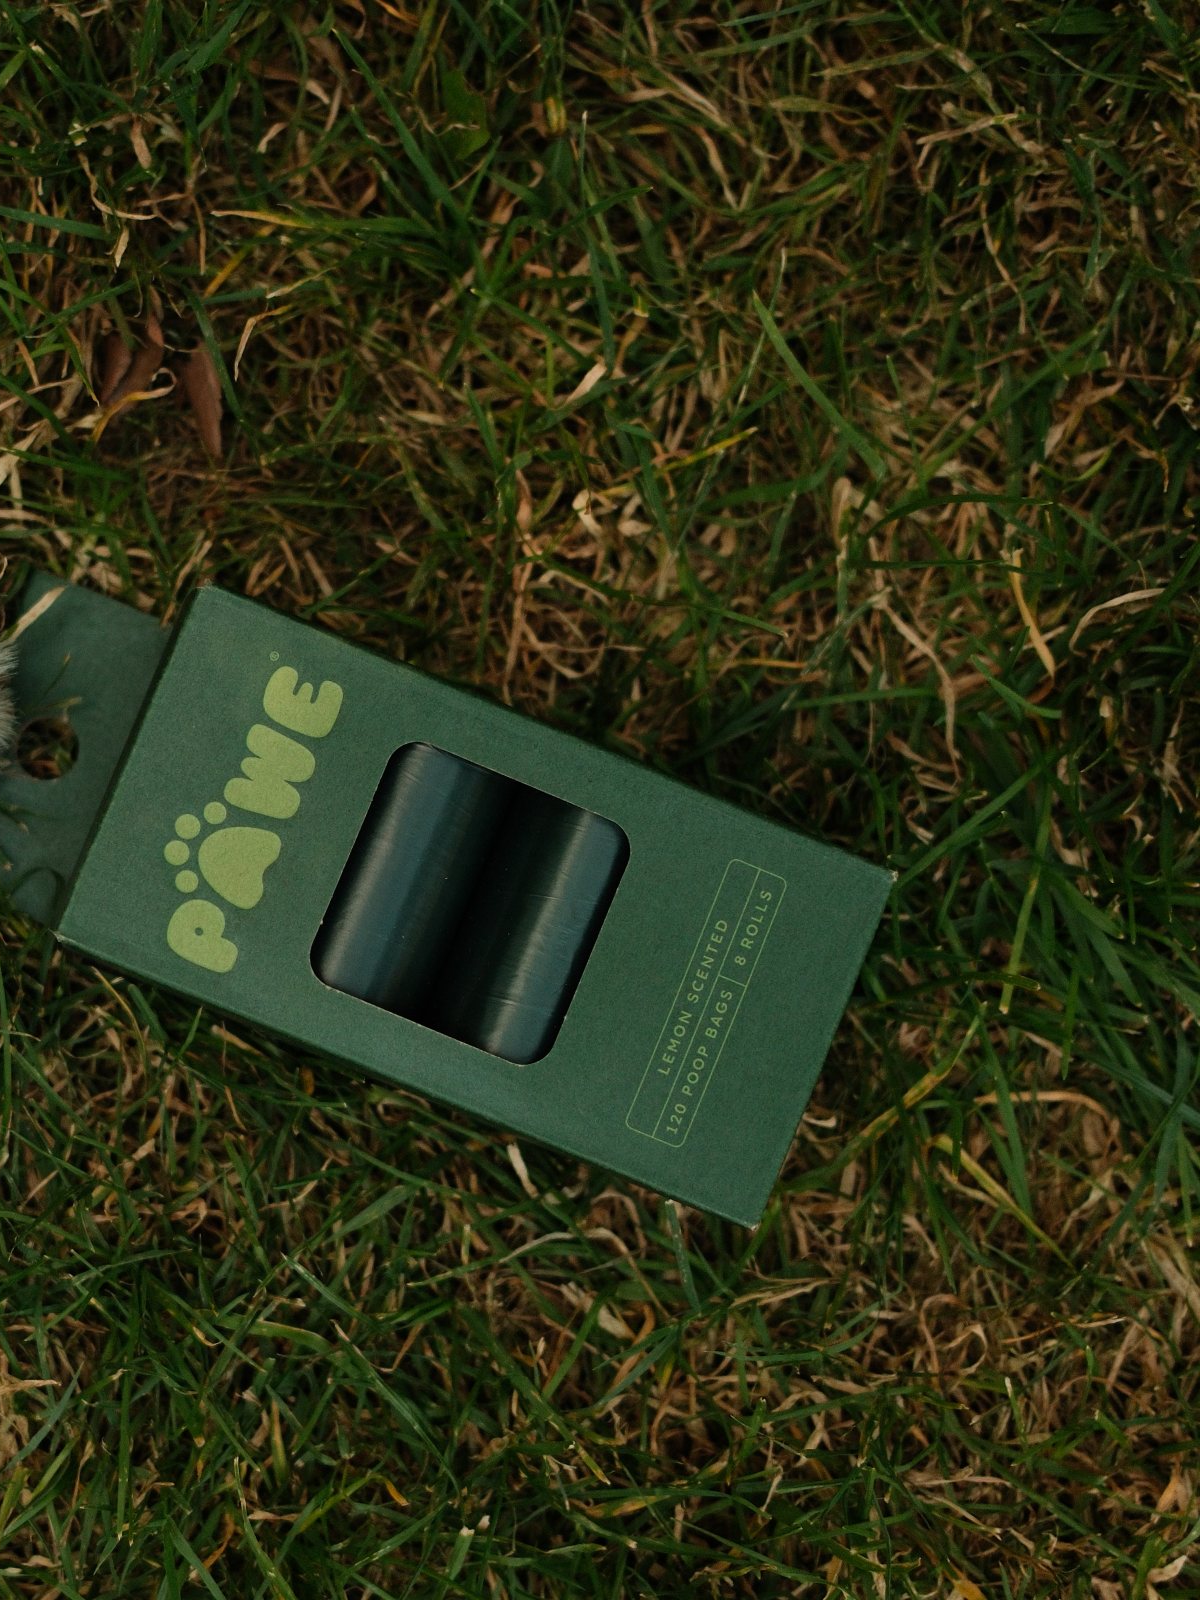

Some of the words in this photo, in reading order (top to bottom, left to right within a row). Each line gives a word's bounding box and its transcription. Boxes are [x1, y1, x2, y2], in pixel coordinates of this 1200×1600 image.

[658, 1010, 692, 1075] LEMON
[687, 920, 728, 1003] SCENTED
[734, 955, 746, 966] 8
[740, 890, 772, 949] ROLLS
[666, 1103, 687, 1134] 120
[681, 1045, 708, 1096] POOP
[705, 990, 732, 1038] BAGS
